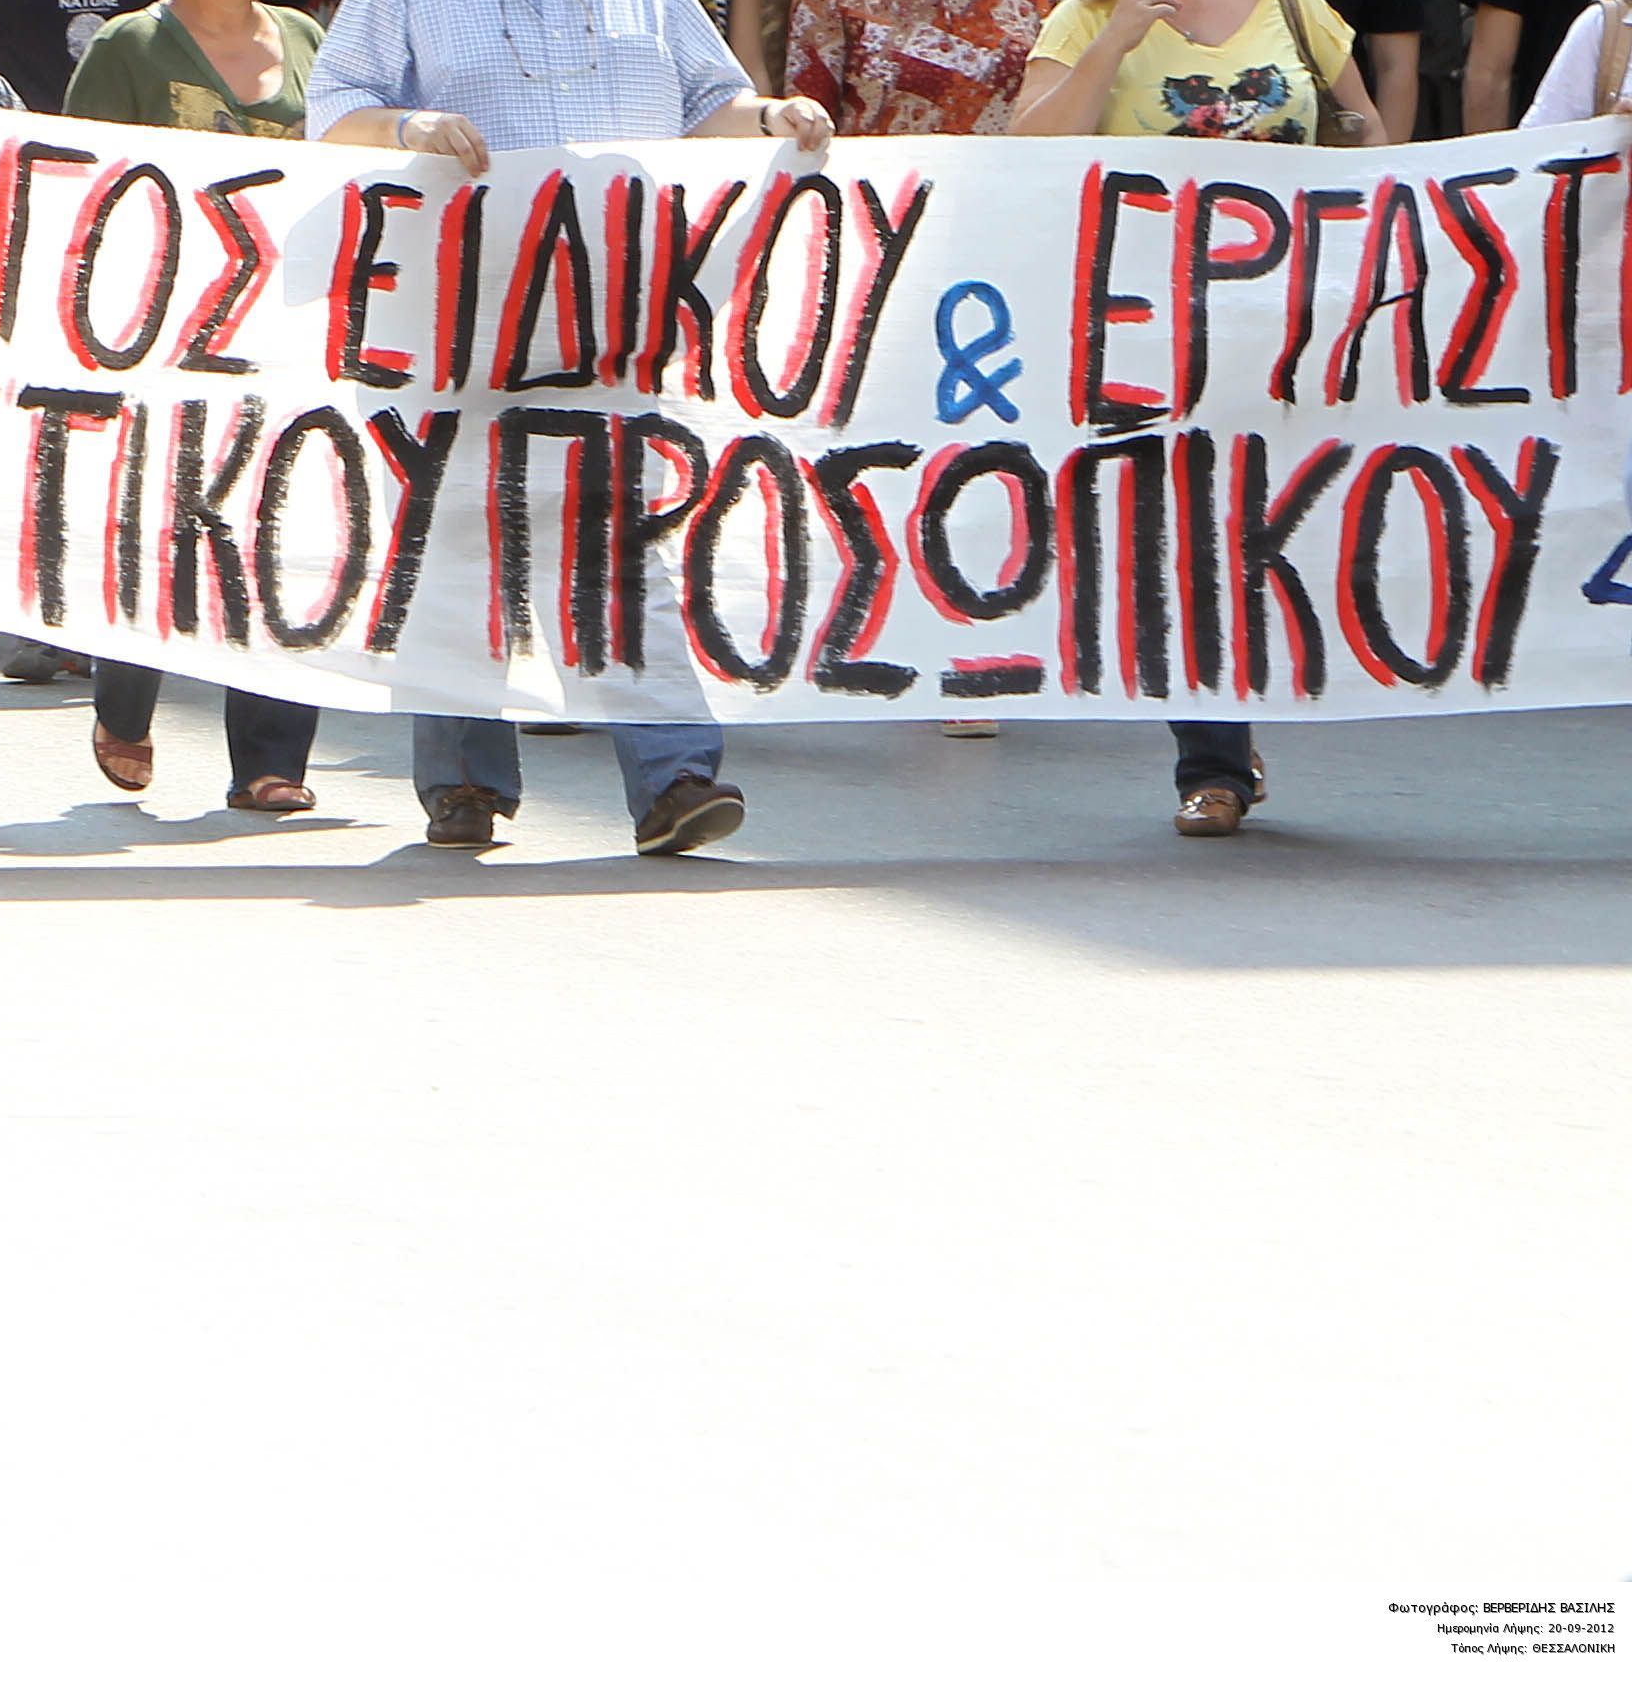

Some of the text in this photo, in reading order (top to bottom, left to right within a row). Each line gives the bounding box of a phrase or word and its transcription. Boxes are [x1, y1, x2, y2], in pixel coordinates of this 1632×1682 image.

[326, 167, 934, 428] ΕΙΔΙΚΟΥ
[935, 279, 1022, 424] &
[484, 404, 1561, 700] ΠΡΟΣΩΠΙΚΟΥ
